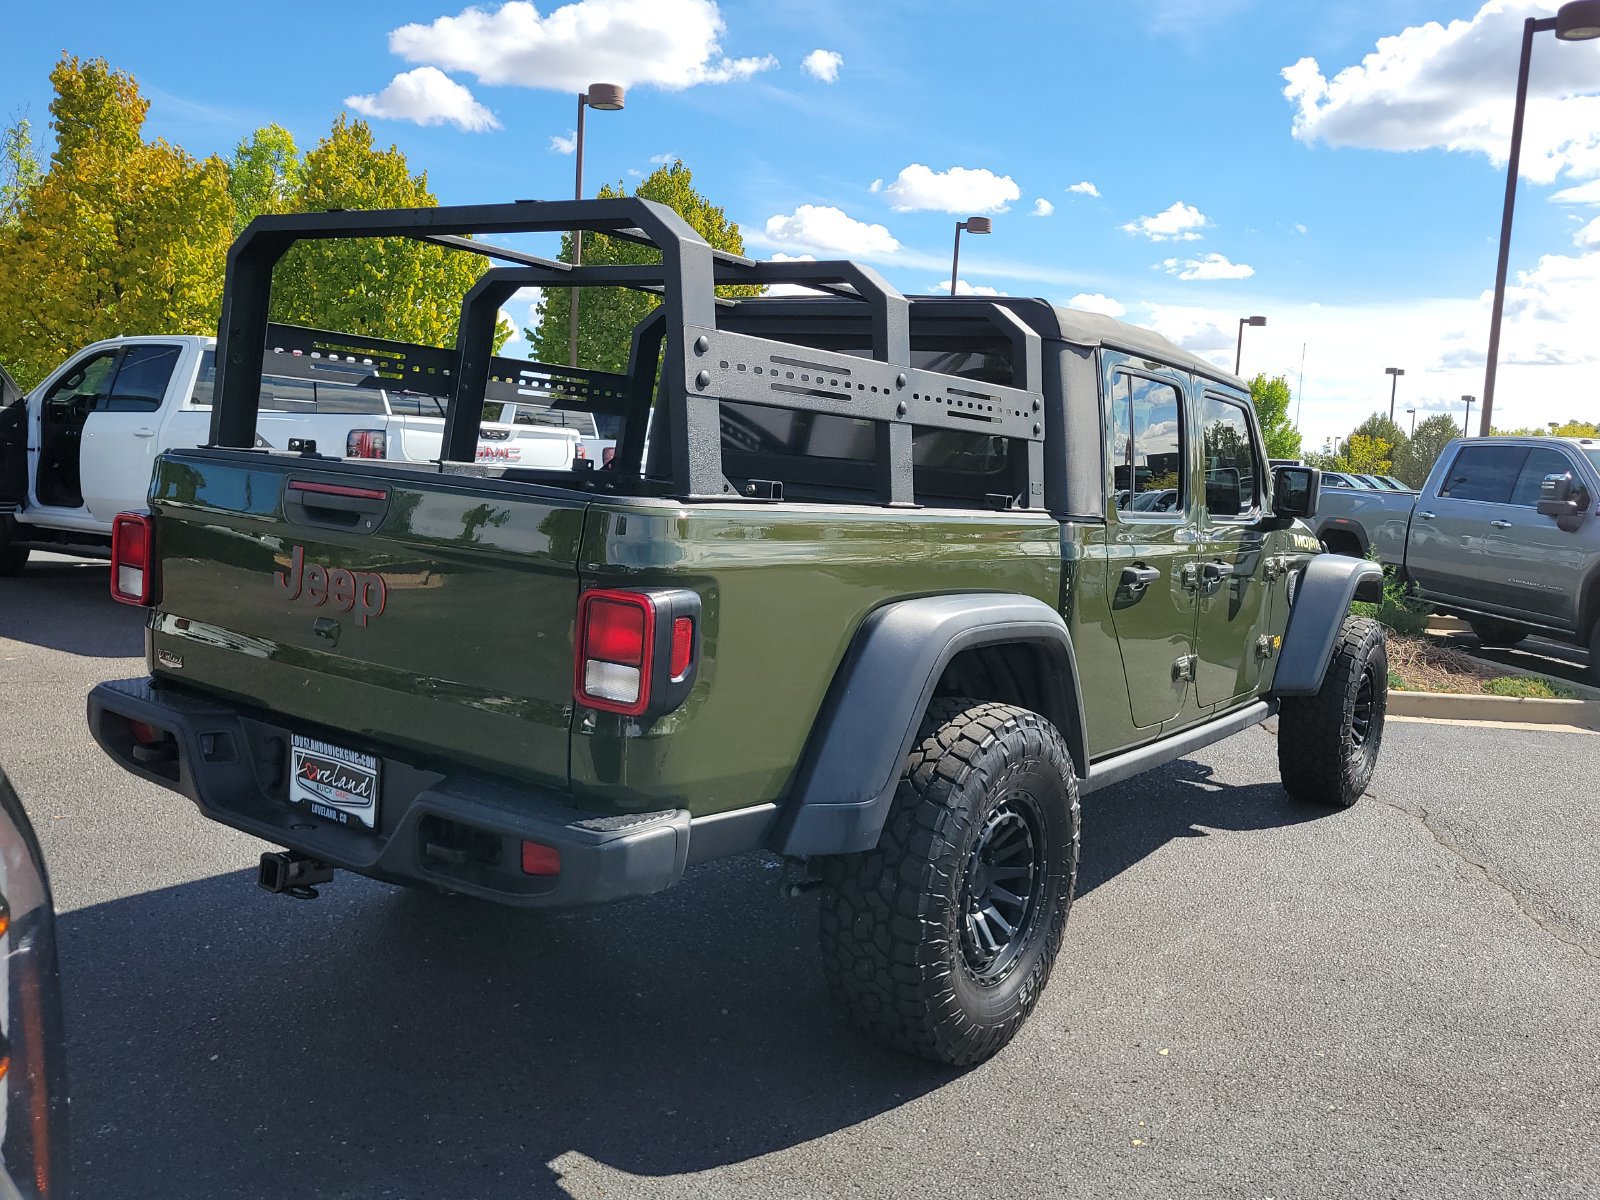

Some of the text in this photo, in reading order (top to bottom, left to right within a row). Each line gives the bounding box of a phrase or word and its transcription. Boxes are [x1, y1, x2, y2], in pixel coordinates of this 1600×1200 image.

[273, 545, 387, 628] Jeep
[296, 753, 370, 796] Loveland
[316, 784, 349, 799] BUICK GMC
[339, 813, 347, 823] CO
